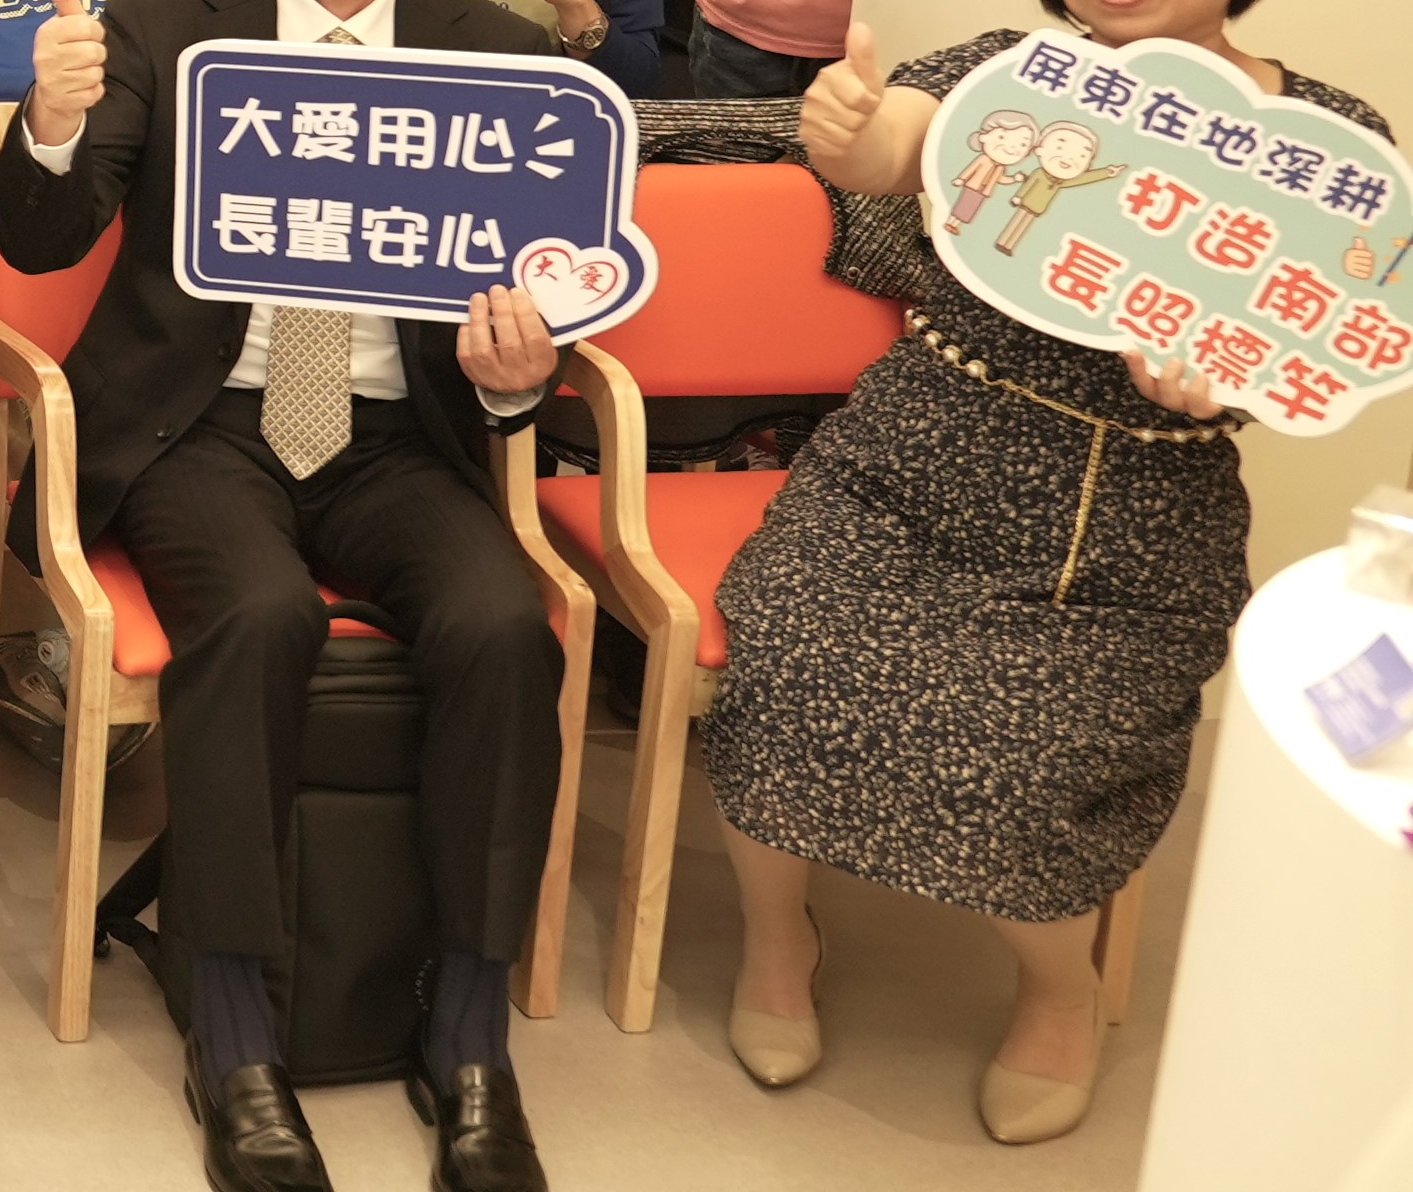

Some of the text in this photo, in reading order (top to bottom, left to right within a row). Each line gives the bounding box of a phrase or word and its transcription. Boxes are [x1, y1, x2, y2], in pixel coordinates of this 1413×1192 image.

[217, 97, 516, 174] 大愛用心
[1018, 41, 1388, 221] 屏東在地深耕
[211, 192, 507, 273] 長輩安心
[1124, 172, 1412, 370] 打造南部
[1046, 238, 1349, 421] 長照標竿
